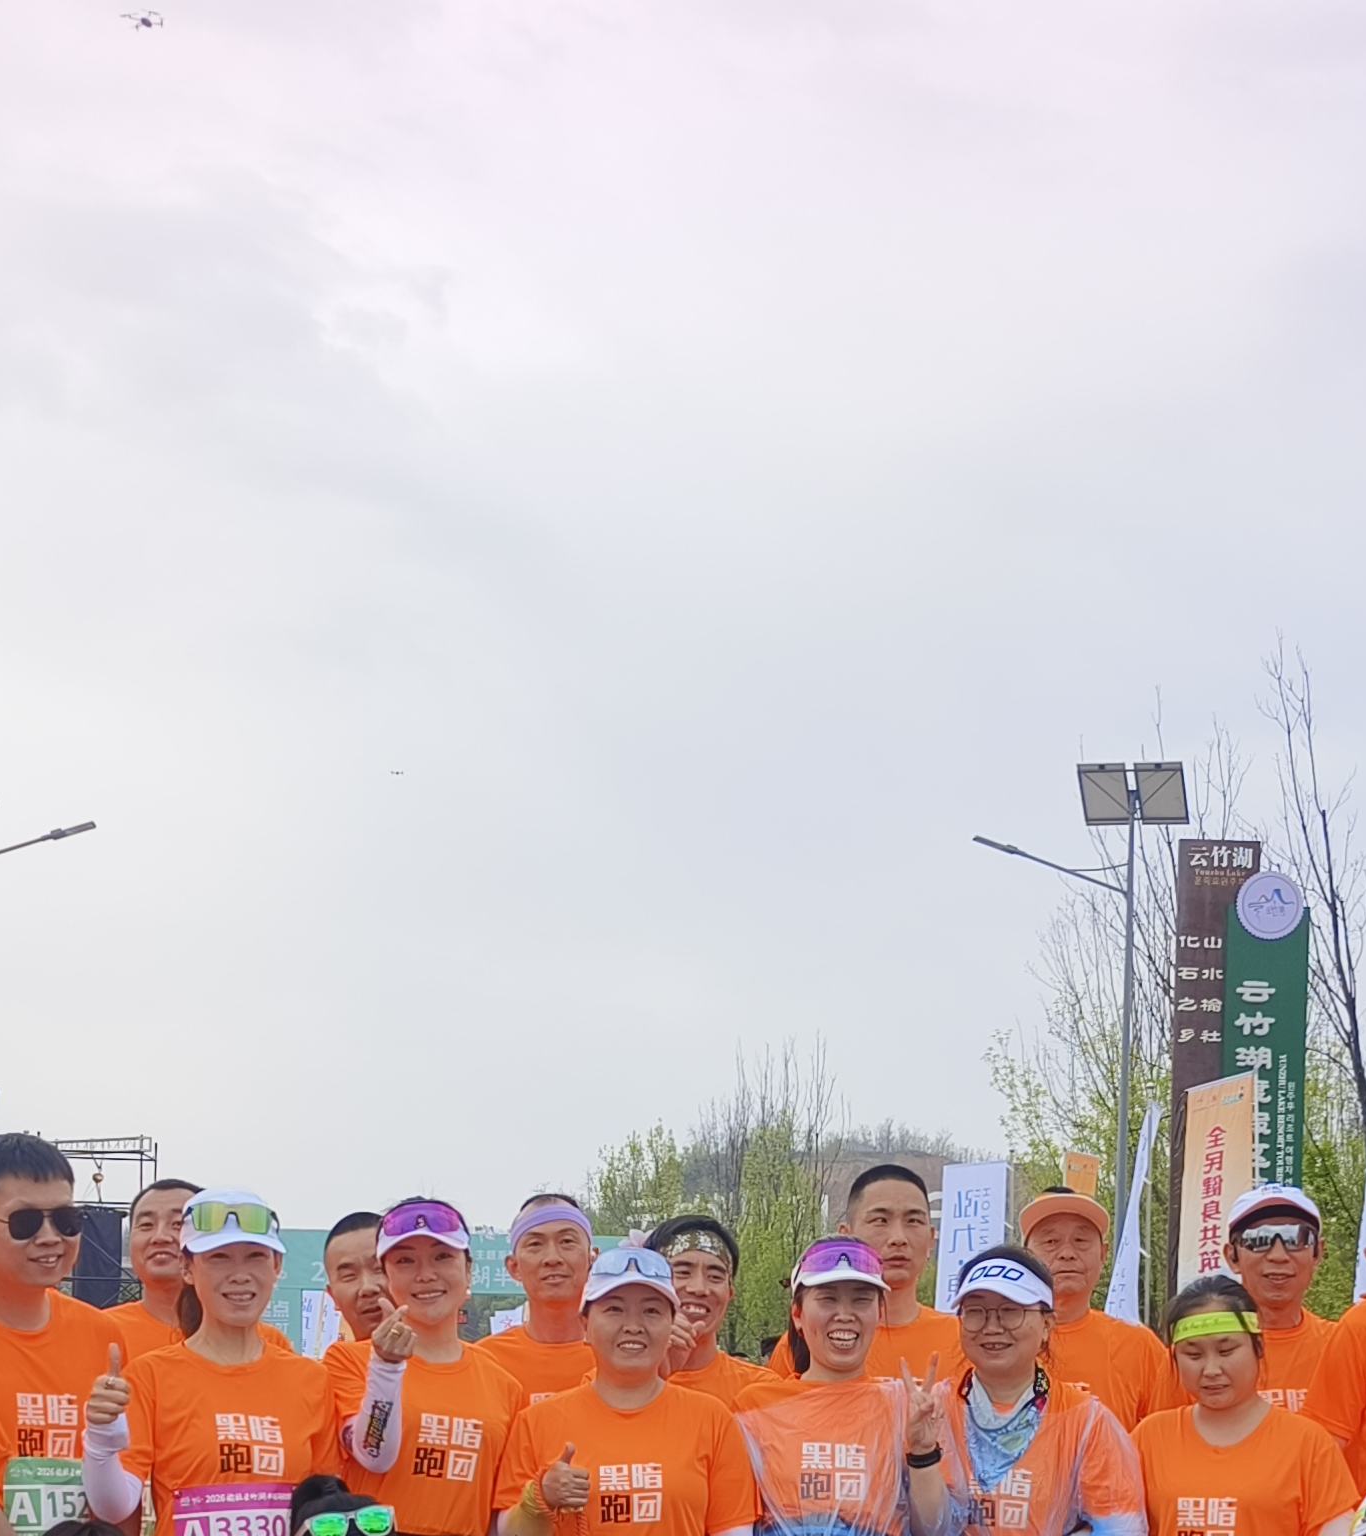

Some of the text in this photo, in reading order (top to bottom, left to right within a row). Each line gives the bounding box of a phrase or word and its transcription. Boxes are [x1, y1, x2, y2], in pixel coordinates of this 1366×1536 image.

[1188, 845, 1254, 869] 云竹湖
[1177, 935, 1200, 1044] 化石之乡
[1200, 936, 1224, 1044] 山水榆社
[1277, 1090, 1287, 1114] LAKE
[16, 1392, 79, 1426] 黑暗
[17, 1429, 78, 1460] 跑团
[215, 1413, 284, 1445] 黑暗
[417, 1413, 484, 1450] 黑暗
[219, 1443, 285, 1477] 跑团
[412, 1448, 479, 1482] 跑团
[801, 1442, 867, 1471] 黑暗
[599, 1463, 664, 1492] 黑暗
[800, 1472, 867, 1502] 跑团
[600, 1492, 663, 1525] 跑团
[968, 1500, 1031, 1531] 跑团
[1176, 1497, 1238, 1527] 黑暗
